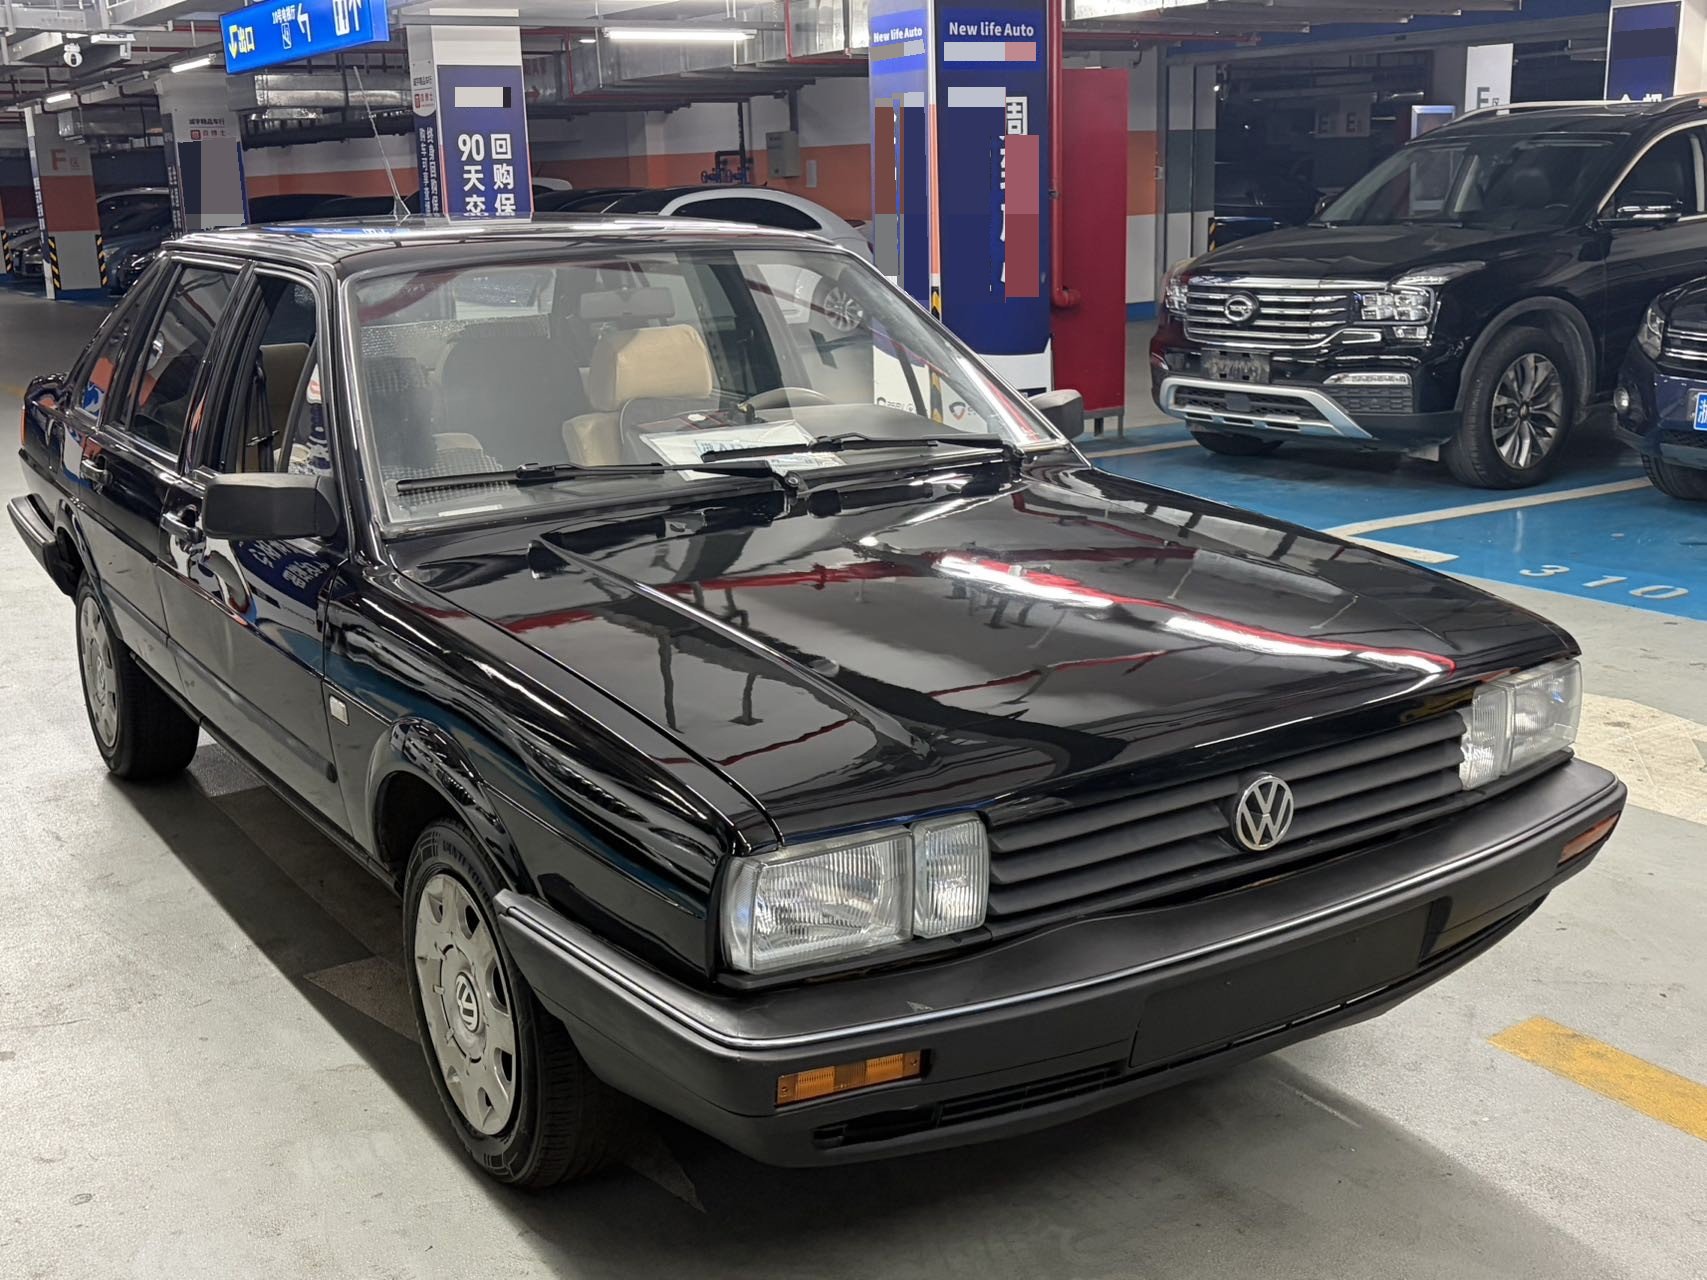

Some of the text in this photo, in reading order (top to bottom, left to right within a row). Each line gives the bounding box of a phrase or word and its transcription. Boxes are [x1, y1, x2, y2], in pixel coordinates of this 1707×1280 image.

[237, 26, 255, 53] 出口
[873, 27, 923, 43] New life Auto
[949, 21, 1035, 37] New life Auto
[1519, 564, 1689, 599] 310
